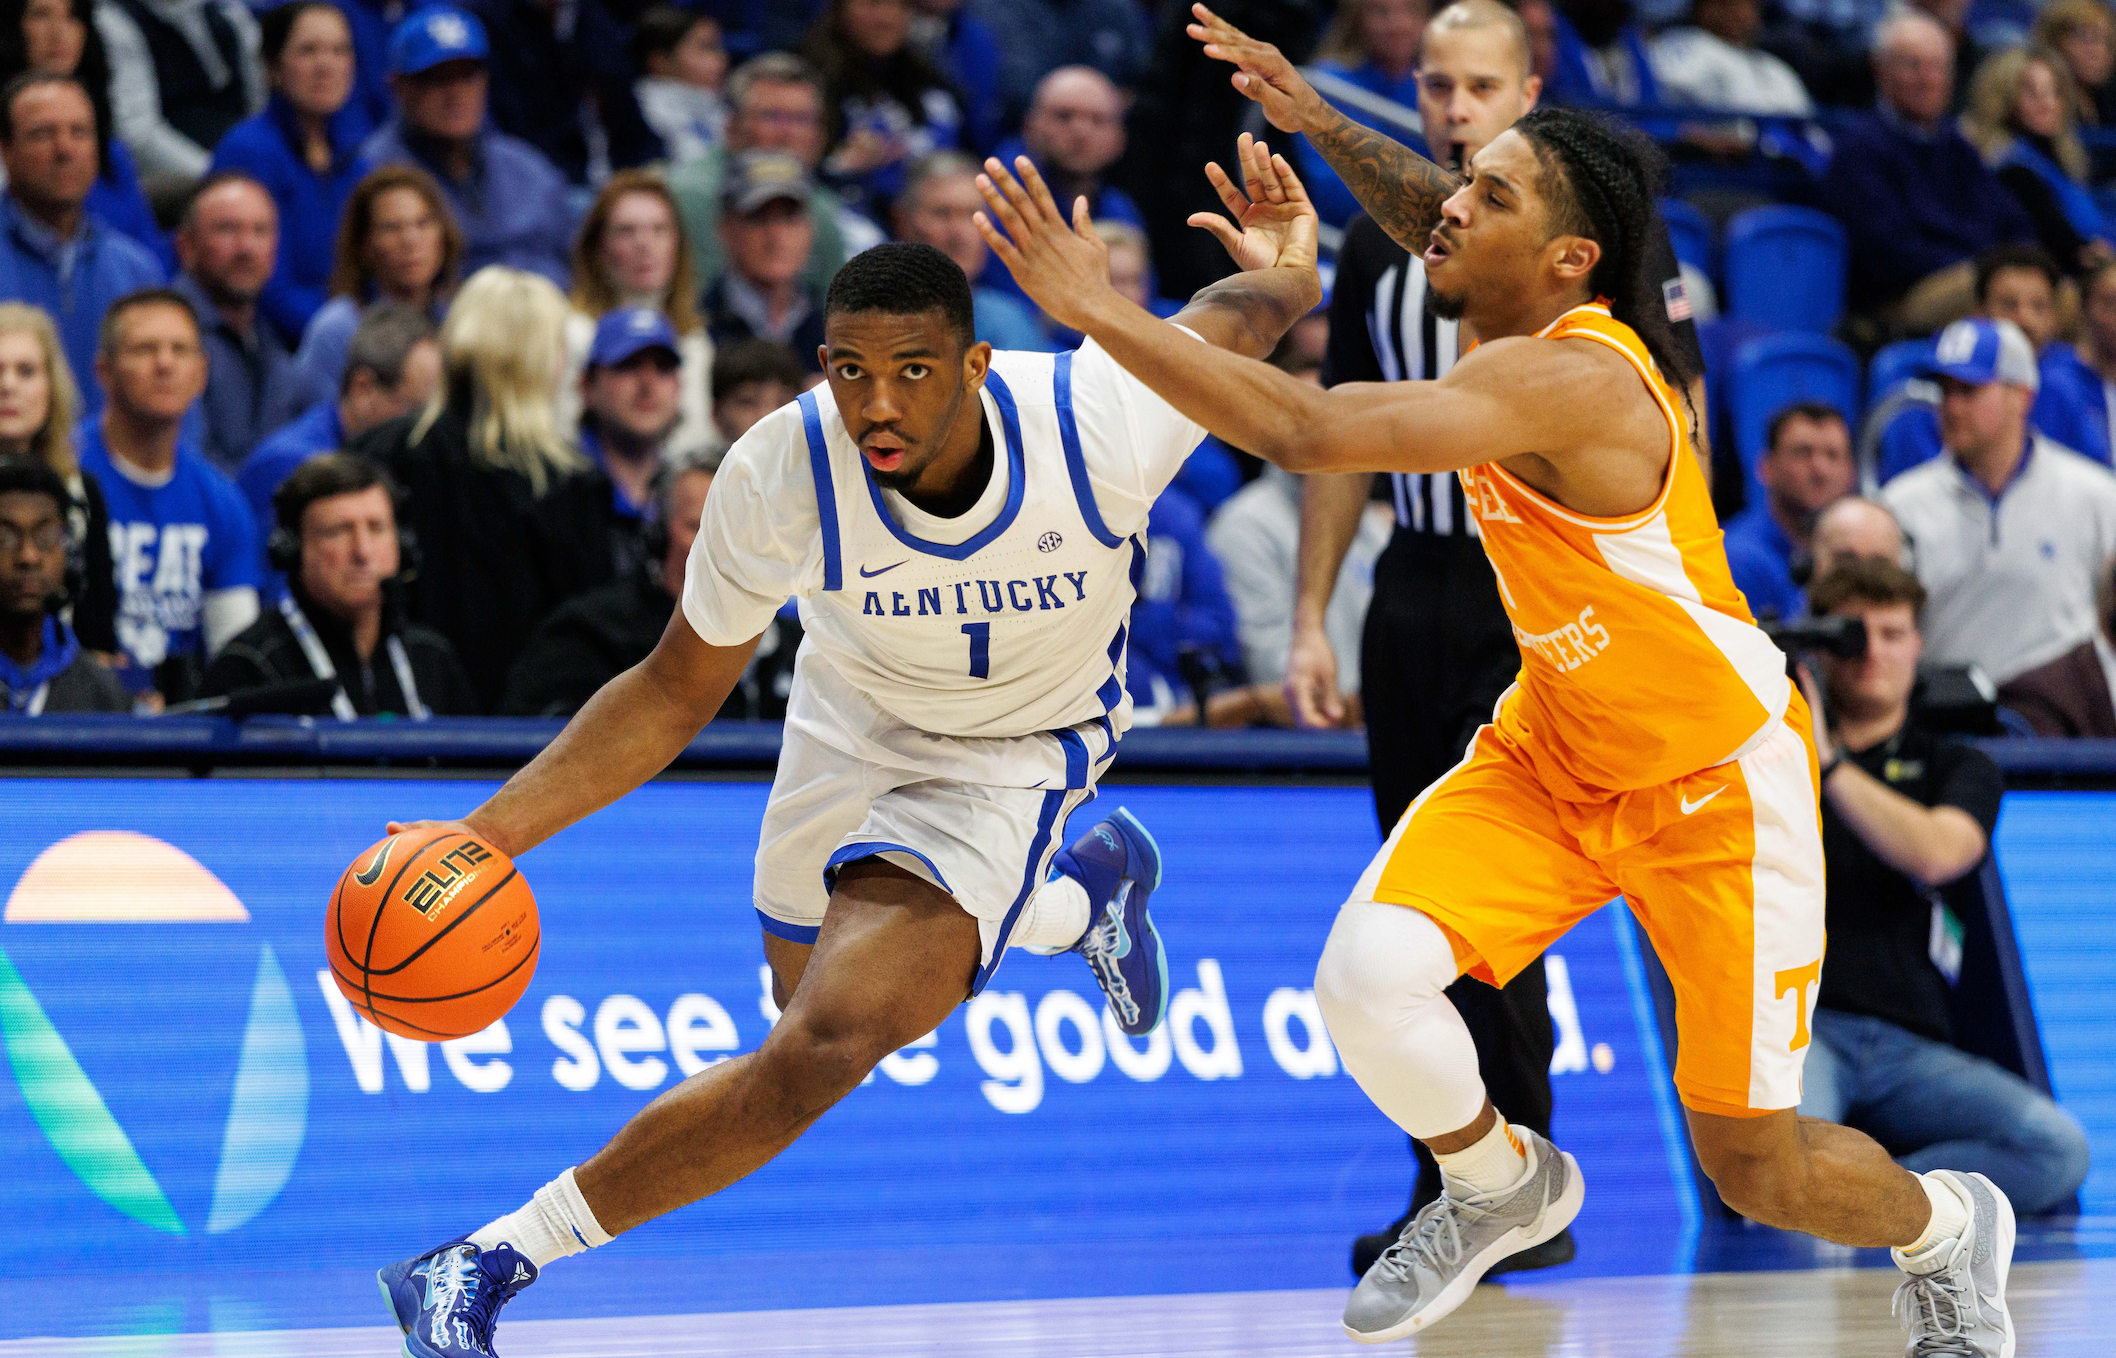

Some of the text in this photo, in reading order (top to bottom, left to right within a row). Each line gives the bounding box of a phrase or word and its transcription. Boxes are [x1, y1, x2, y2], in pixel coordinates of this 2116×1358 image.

[1037, 531, 1063, 553] SEC
[961, 621, 990, 680] 1
[402, 840, 493, 916] ELITE
[541, 993, 740, 1091] see
[965, 958, 1245, 1115] good
[1774, 957, 1821, 1053] T
